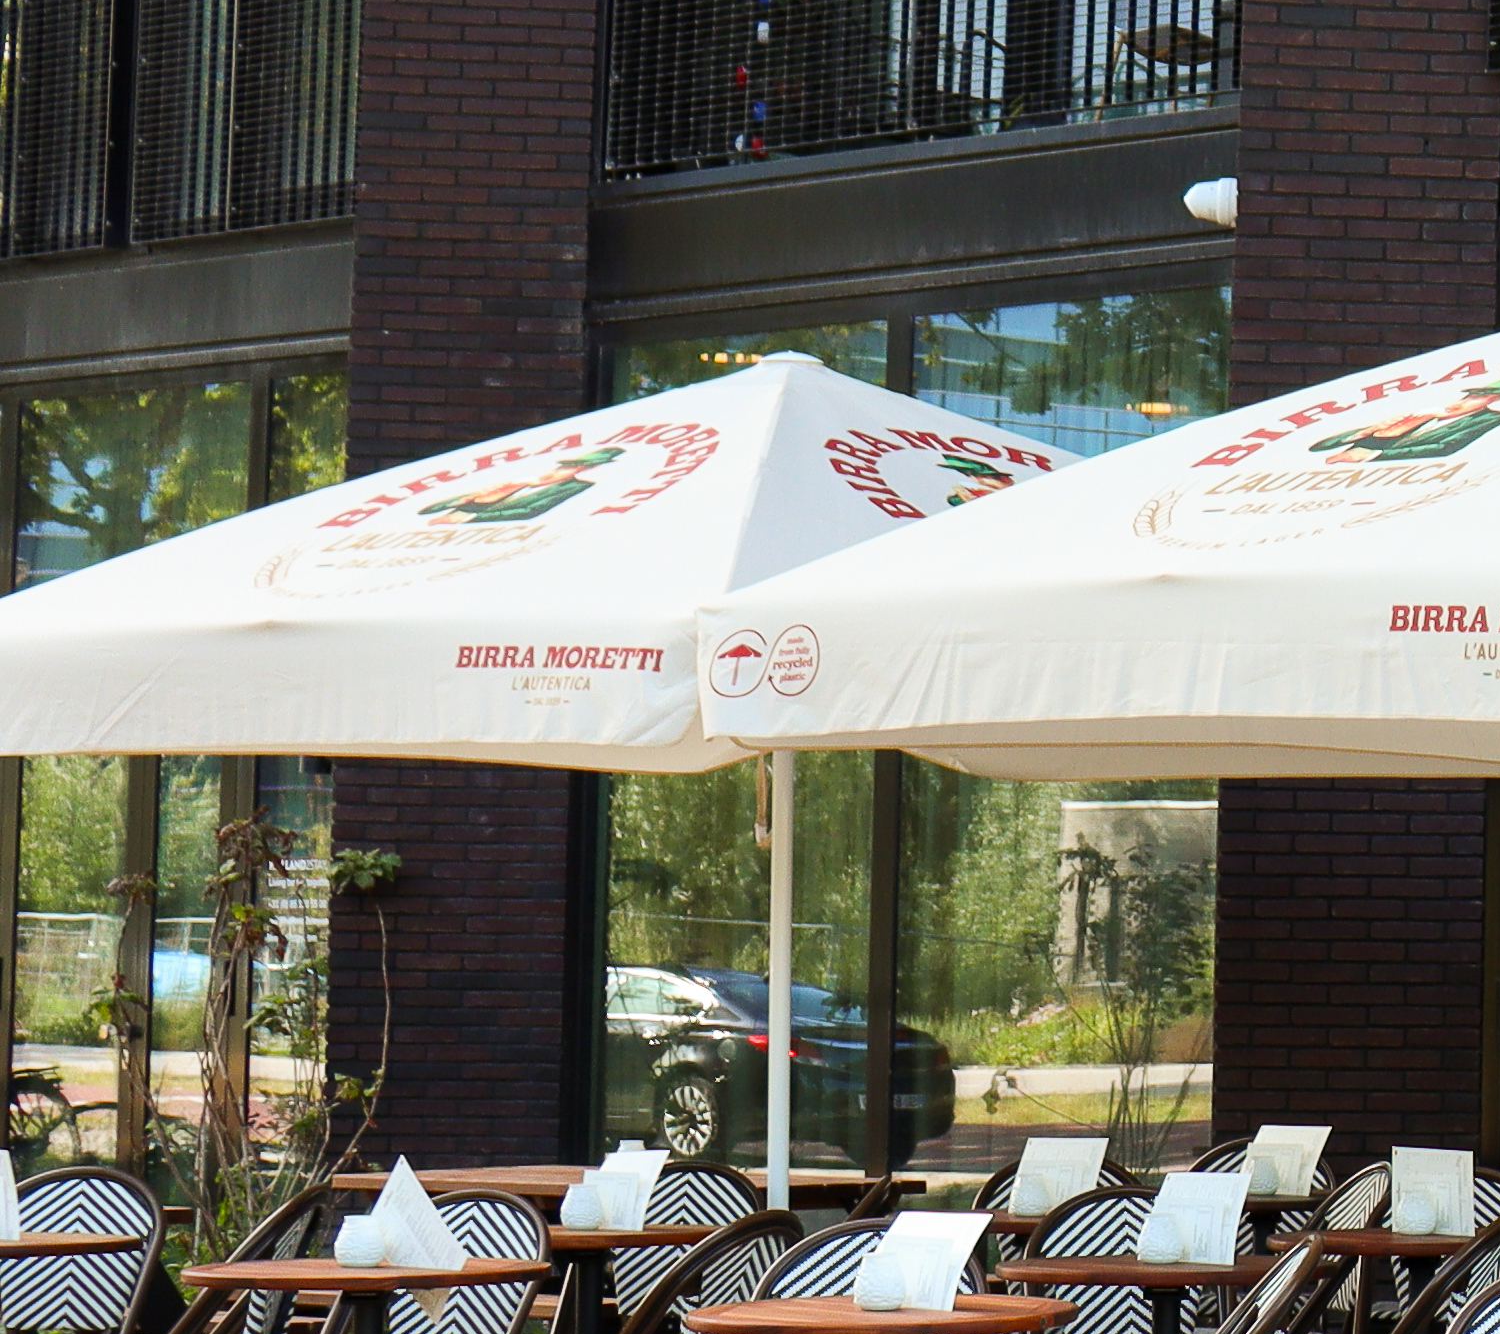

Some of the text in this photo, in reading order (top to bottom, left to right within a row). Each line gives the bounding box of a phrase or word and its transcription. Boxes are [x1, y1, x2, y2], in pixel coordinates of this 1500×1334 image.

[1190, 359, 1490, 468] BIRRA
[316, 422, 720, 528] BIRRA MORETTI
[823, 429, 928, 518] BIRRA
[1203, 461, 1469, 495] L'AUTENTICA
[1389, 604, 1489, 633] BIRRA
[455, 645, 664, 672] BIRRA MORETTI
[773, 656, 812, 671] recycled
[512, 676, 591, 691] L'AUTENTICA
